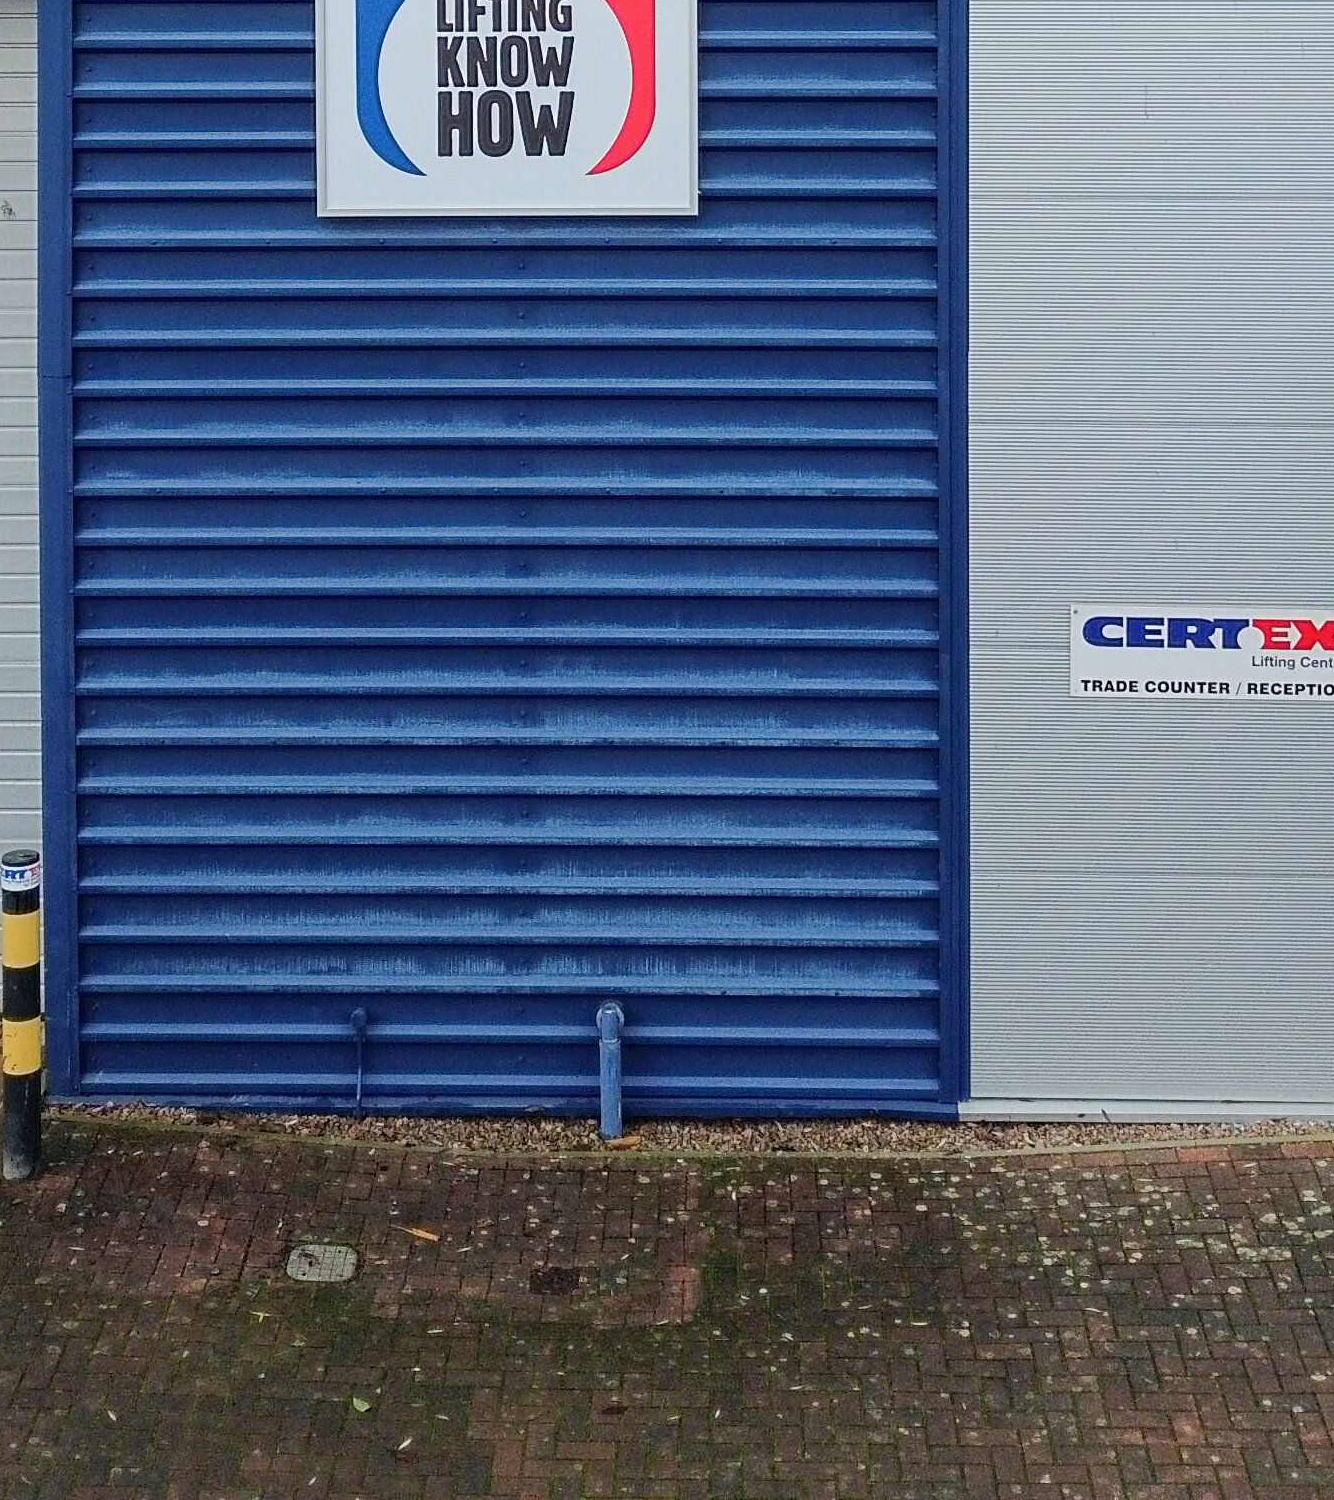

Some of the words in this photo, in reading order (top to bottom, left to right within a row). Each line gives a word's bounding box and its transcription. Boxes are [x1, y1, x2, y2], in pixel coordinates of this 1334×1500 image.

[436, 35, 575, 88] KNOW
[437, 90, 575, 158] HOW
[1251, 655, 1296, 670] Lifting
[1080, 679, 1139, 694] TRADE
[1144, 680, 1231, 695] COUNTER
